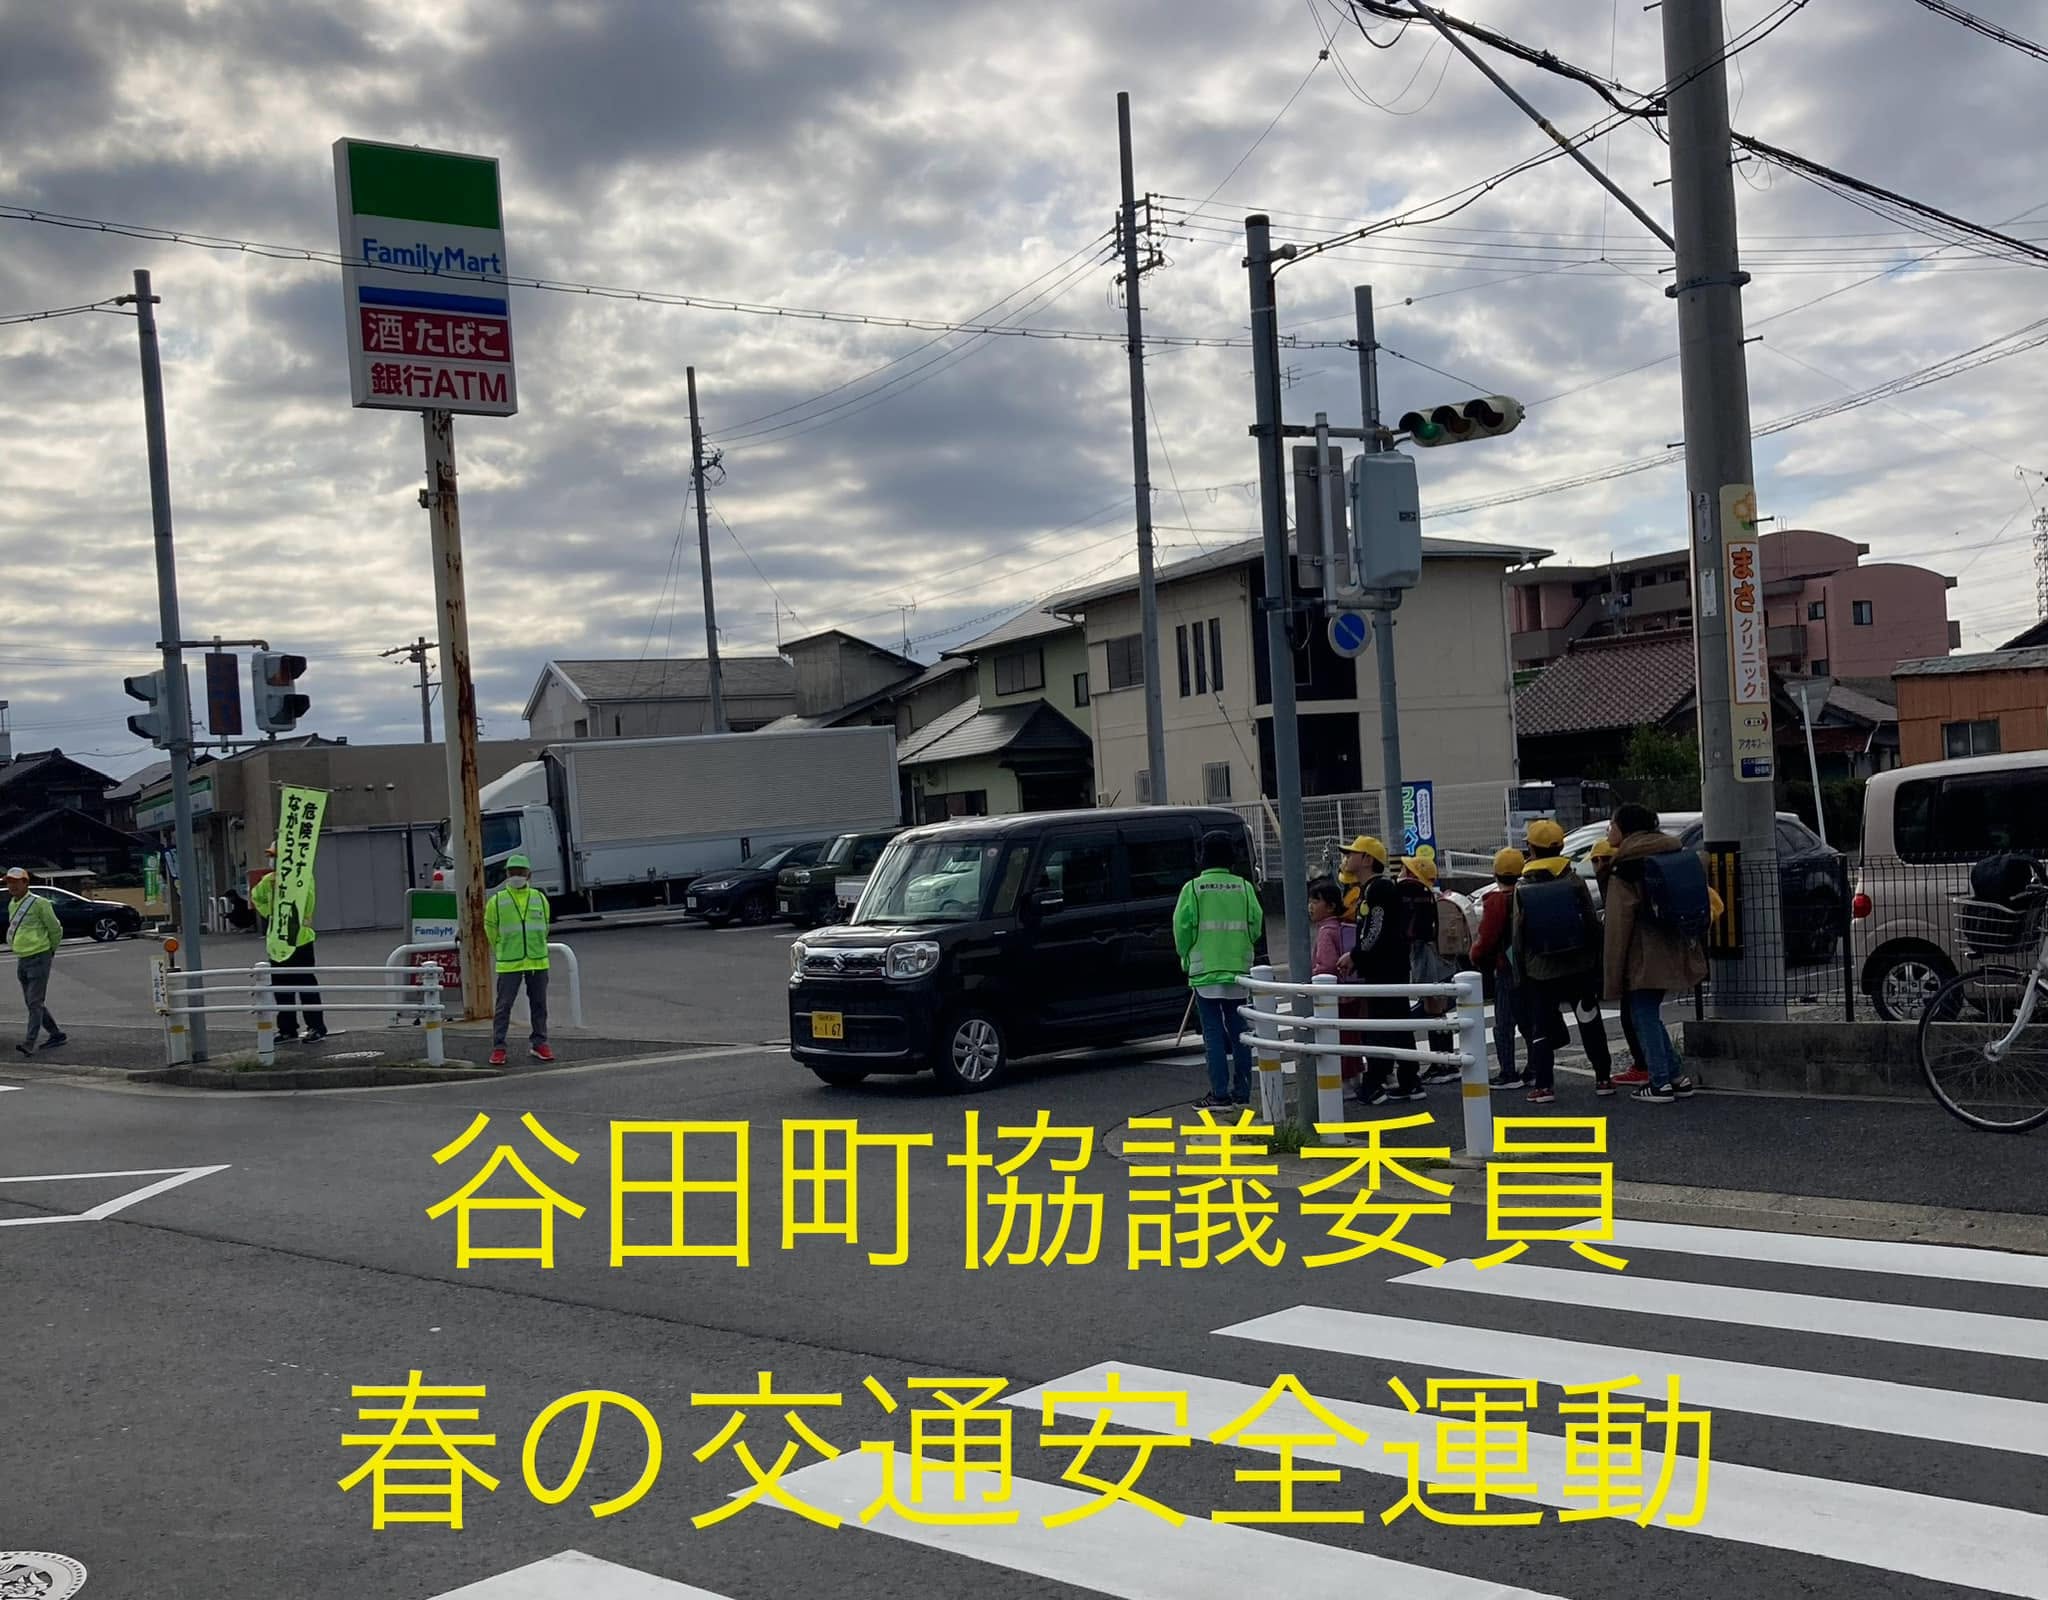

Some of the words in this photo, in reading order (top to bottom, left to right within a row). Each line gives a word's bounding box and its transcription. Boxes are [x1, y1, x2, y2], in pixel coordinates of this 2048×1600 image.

[362, 237, 500, 273] FamilyMart
[367, 311, 505, 357] 酒・たばこ
[370, 361, 508, 403] 銀行ATM
[278, 793, 302, 899] ながらスマホ
[296, 801, 318, 888] 危険です。
[414, 926, 454, 937] FamilyM
